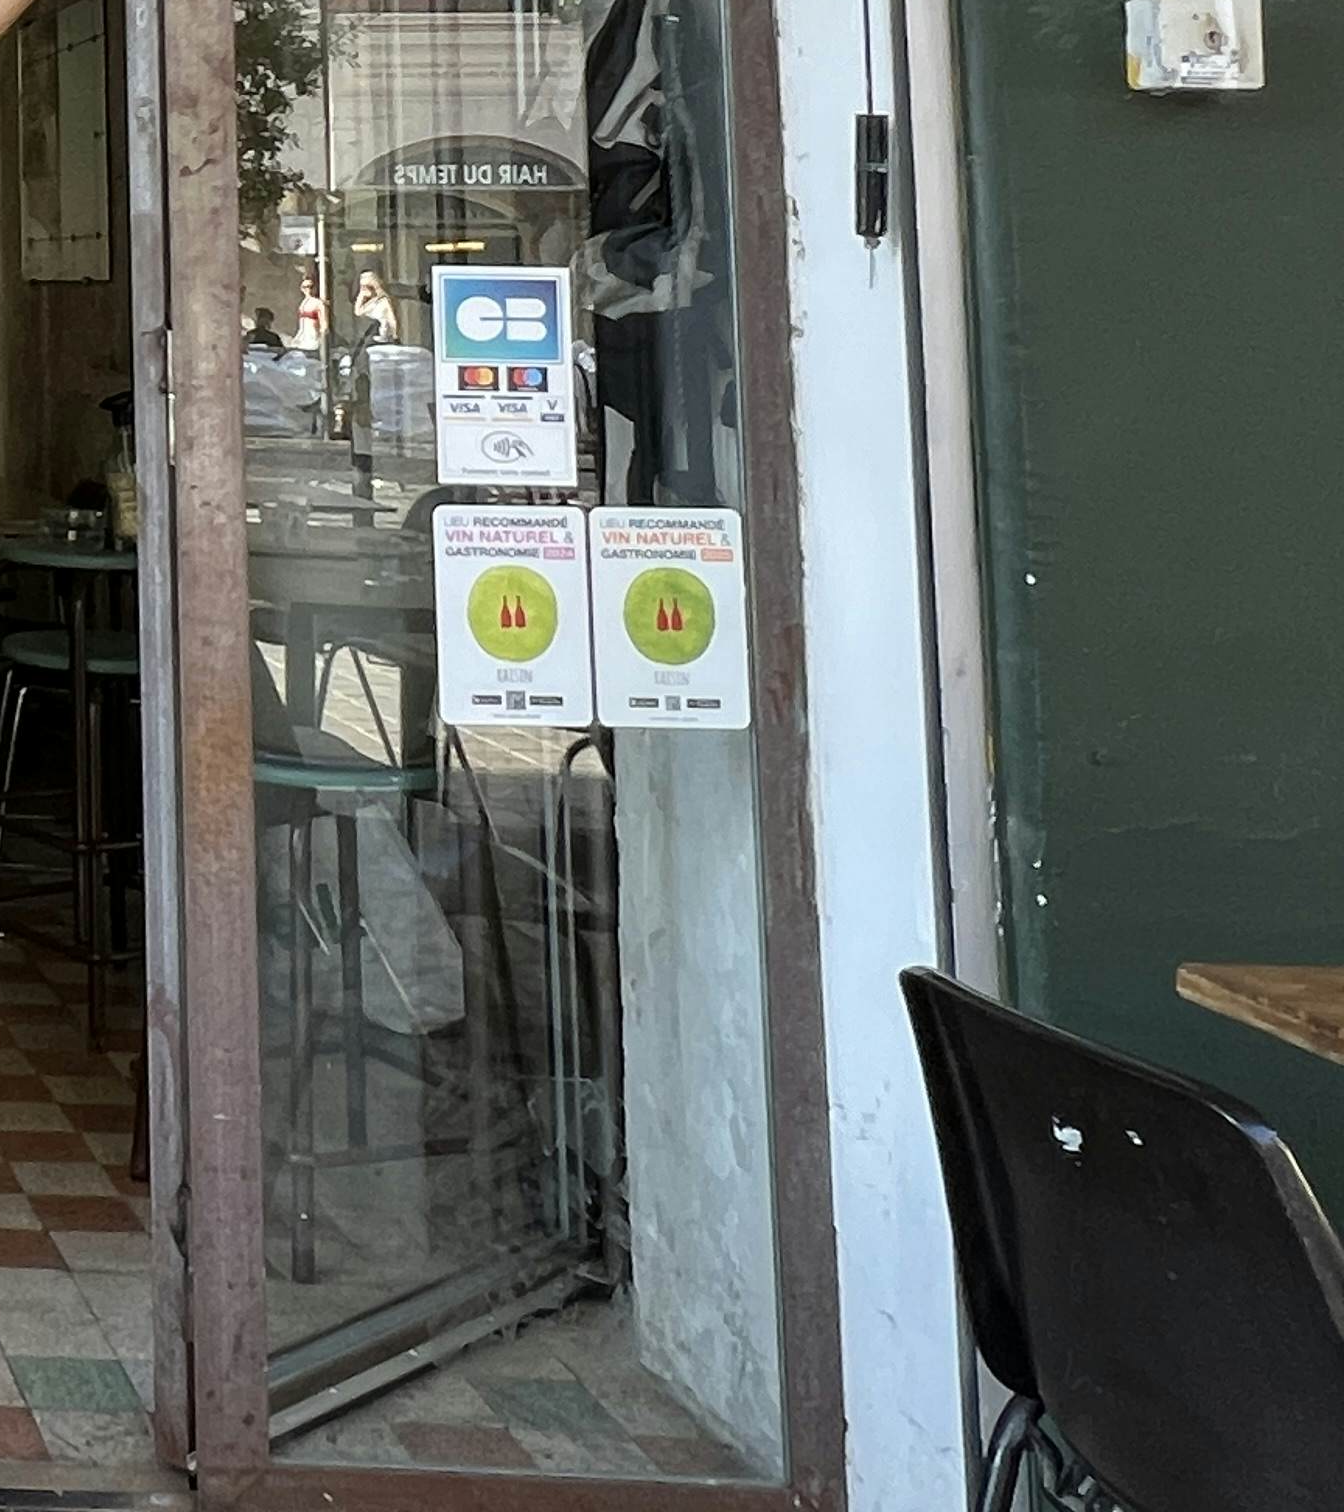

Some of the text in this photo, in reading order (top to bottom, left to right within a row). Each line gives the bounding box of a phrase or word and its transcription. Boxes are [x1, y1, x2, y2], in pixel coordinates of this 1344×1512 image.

[456, 296, 547, 341] CB
[450, 402, 481, 414] VISA
[497, 402, 528, 414] VISA
[443, 516, 469, 527] LIEU
[445, 530, 574, 544] VIN NATUREL &
[602, 532, 731, 546] VIN NATUREL &
[445, 546, 540, 558] GASTRONOMIE
